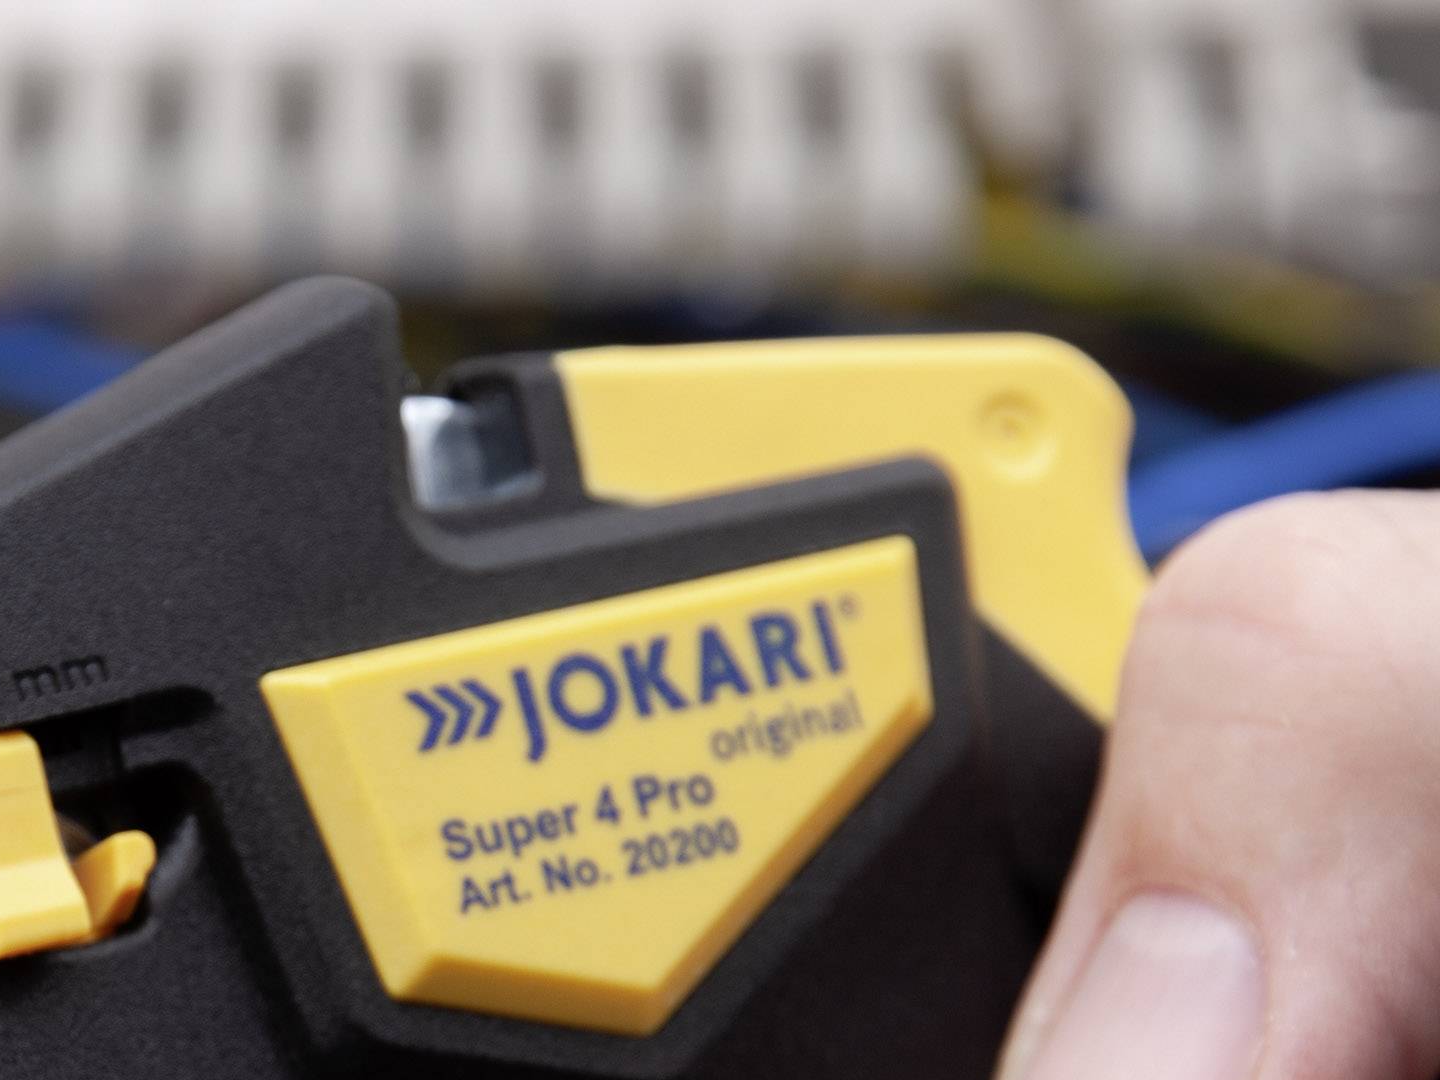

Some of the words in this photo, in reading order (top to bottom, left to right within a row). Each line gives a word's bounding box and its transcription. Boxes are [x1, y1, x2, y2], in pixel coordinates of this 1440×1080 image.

[12, 654, 109, 698] mm
[511, 600, 845, 763] JOKARI
[710, 690, 863, 762] original
[441, 804, 578, 862] Super
[595, 787, 621, 826] 4
[631, 774, 714, 819] Pro
[460, 871, 530, 913] Art.
[541, 856, 612, 894] No.
[622, 818, 739, 876] 20200
